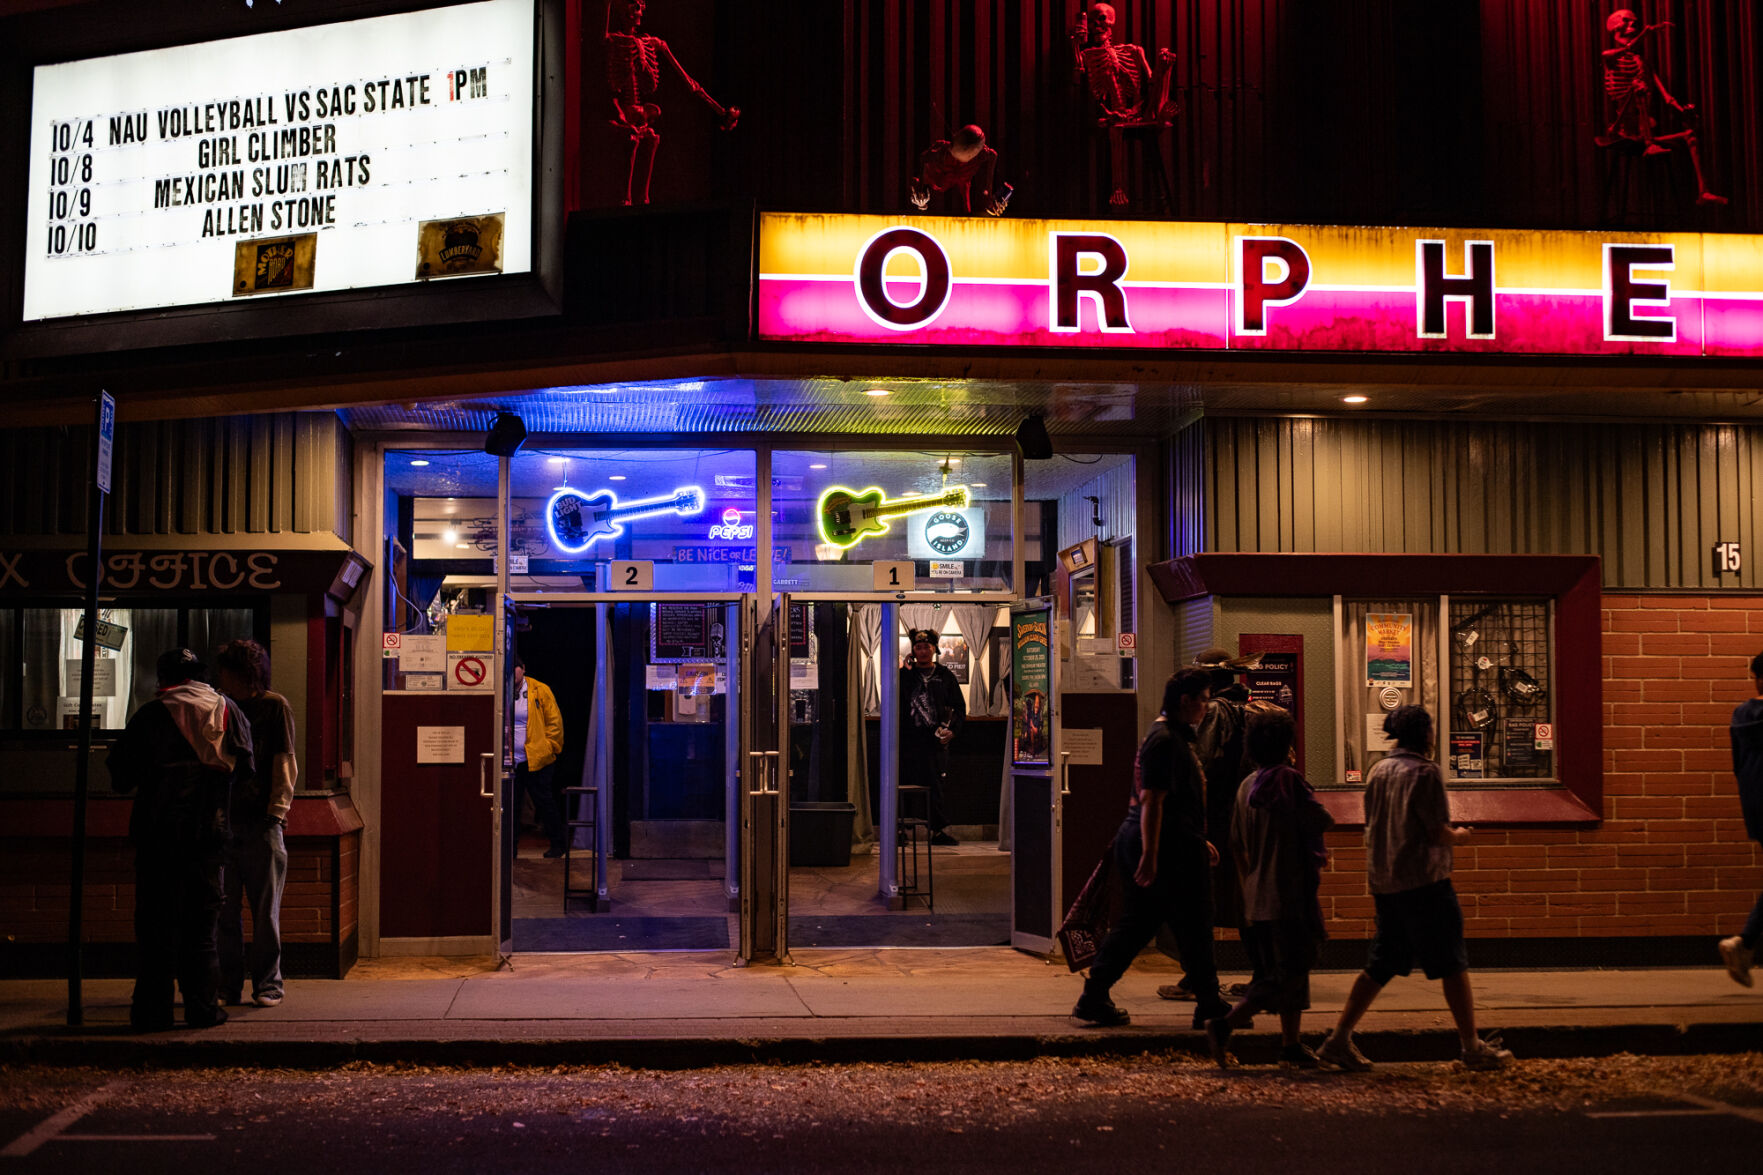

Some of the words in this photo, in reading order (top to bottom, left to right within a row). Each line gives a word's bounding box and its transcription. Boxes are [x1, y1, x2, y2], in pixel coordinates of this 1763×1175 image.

[52, 119, 94, 153] 10/4
[109, 112, 148, 146] NAU
[157, 95, 278, 139] VOLLEYBALL
[284, 90, 311, 123] VS
[315, 83, 357, 119] SAC
[363, 74, 431, 113] STATE
[446, 66, 488, 102] 1PM
[50, 153, 93, 187] 10/8
[198, 135, 242, 169] GIRL
[247, 123, 336, 163] CLIMBER
[48, 187, 92, 221] 10/9
[154, 169, 245, 209] MEXICAN
[252, 162, 307, 197] SLUM
[316, 154, 371, 191] RATS
[47, 222, 97, 255] 10/10
[201, 202, 264, 238] ALLEN
[270, 194, 336, 231] STONE
[853, 224, 1679, 344] ORPHE
[554, 500, 582, 519] LIGHT
[555, 496, 576, 510] BUD
[933, 513, 962, 524] GOOSE
[708, 525, 754, 540] PEPSI
[933, 539, 963, 552] ISLAND
[677, 548, 693, 562] BE
[1716, 543, 1741, 571] 15
[625, 567, 638, 585] 2
[889, 567, 900, 585] 1
